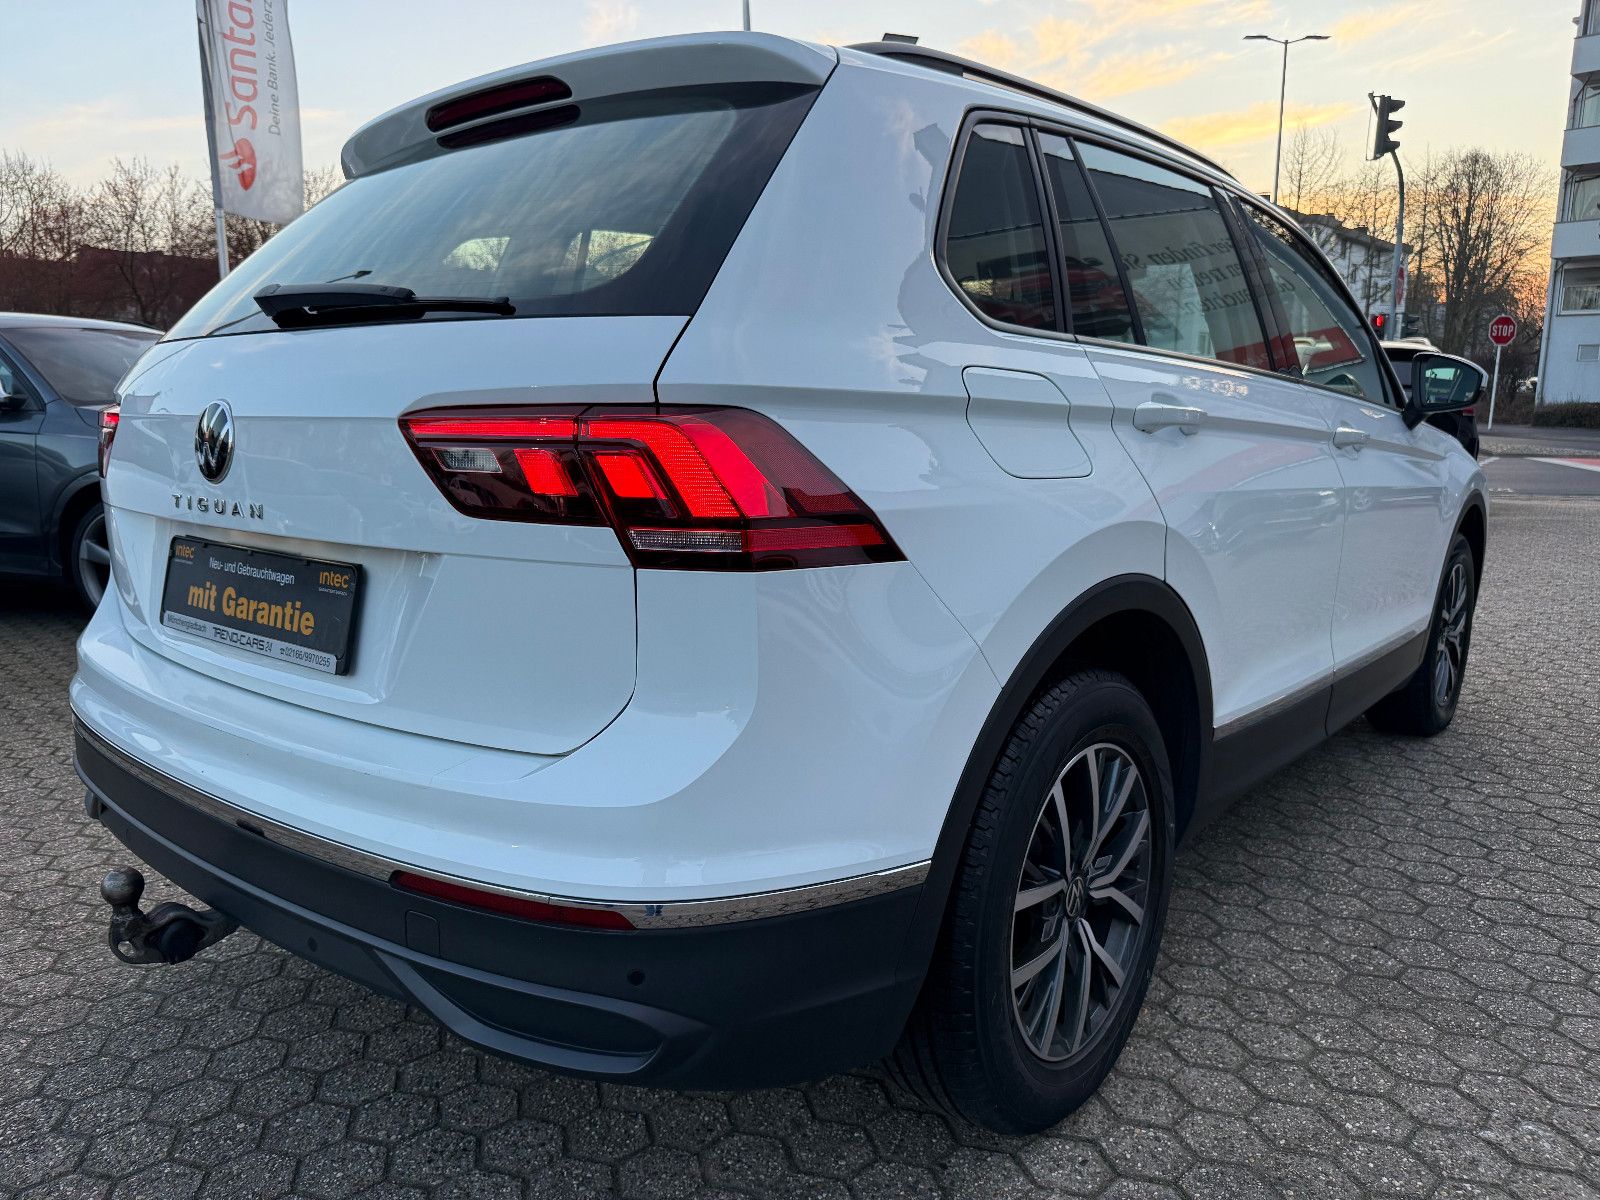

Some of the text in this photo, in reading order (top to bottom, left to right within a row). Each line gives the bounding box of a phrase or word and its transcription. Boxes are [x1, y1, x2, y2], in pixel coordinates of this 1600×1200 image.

[223, 0, 258, 131] Santa
[264, 51, 279, 91] Bank.
[267, 94, 281, 137] Deine
[1491, 324, 1515, 337] STOP
[171, 494, 265, 521] TIGUAN
[175, 544, 195, 559] intec
[209, 556, 223, 570] Neu-
[224, 561, 237, 573] und
[237, 562, 295, 586] Gebrauchtwagen
[319, 570, 350, 589] intec
[187, 581, 315, 636] mit Garantie
